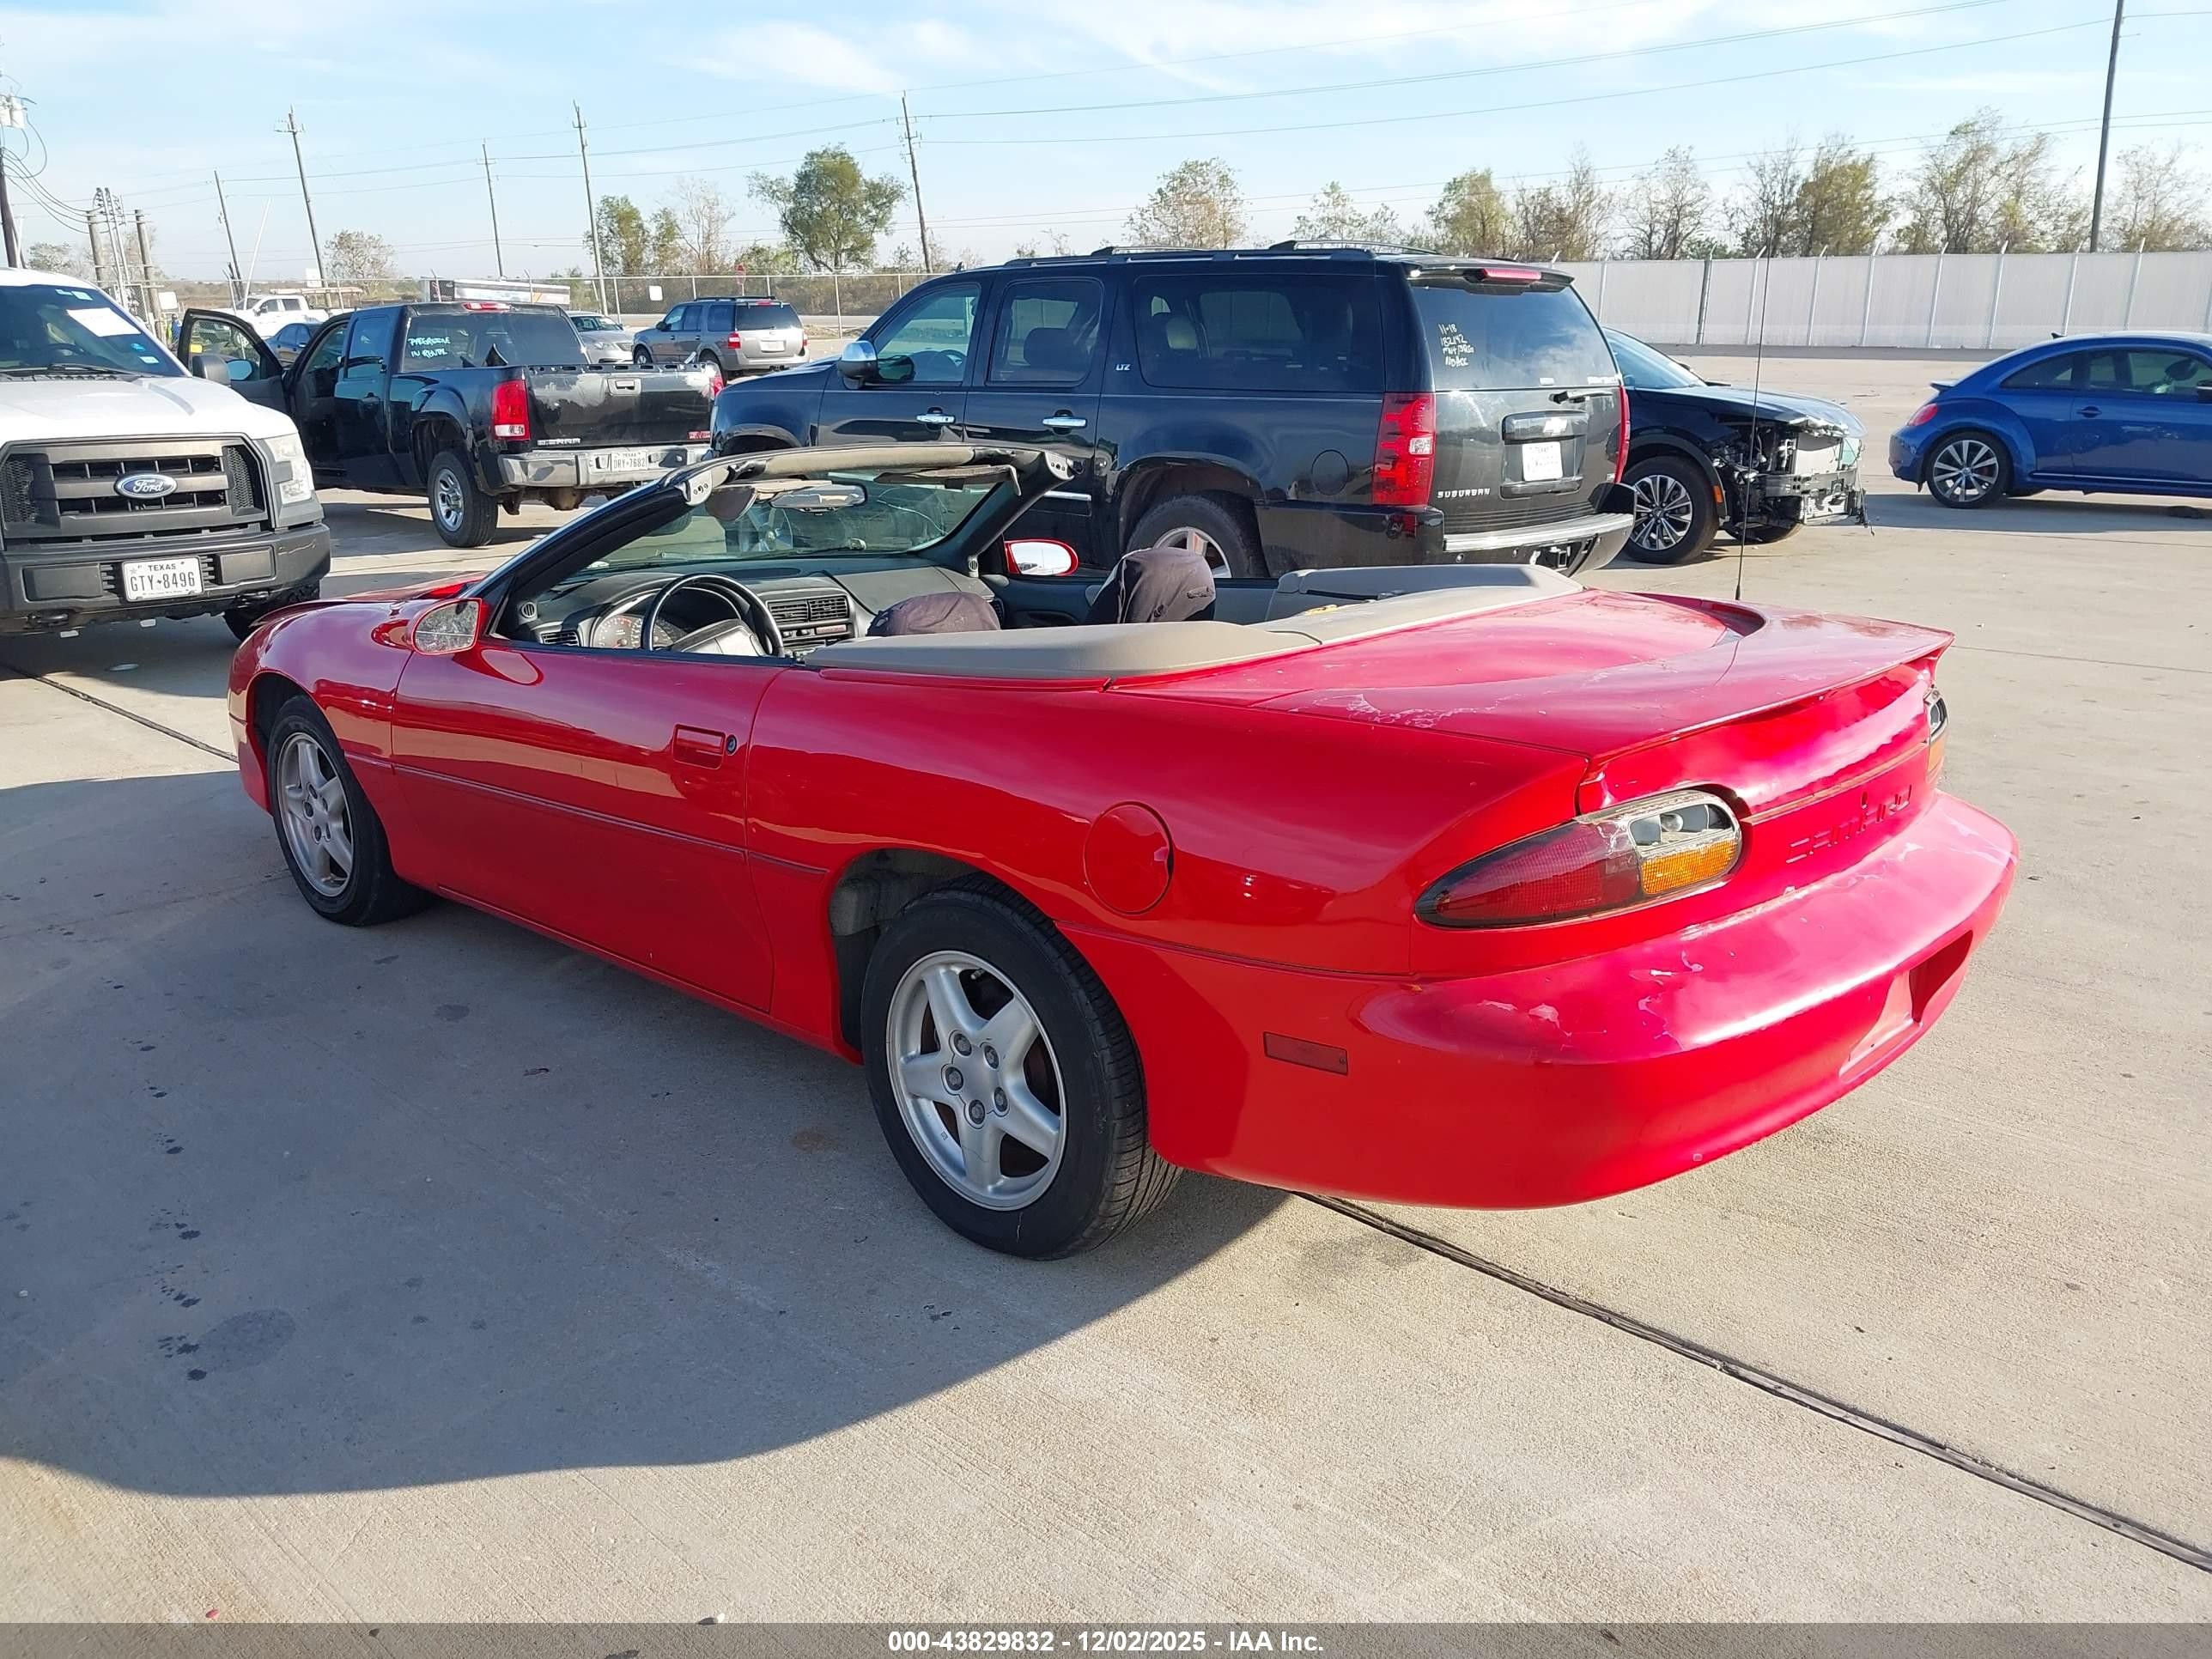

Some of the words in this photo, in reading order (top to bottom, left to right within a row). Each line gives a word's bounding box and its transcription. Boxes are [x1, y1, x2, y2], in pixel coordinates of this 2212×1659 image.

[132, 478, 164, 493] Ford
[1437, 487, 1491, 499] SUBURBAN
[148, 563, 177, 572] TEXAS
